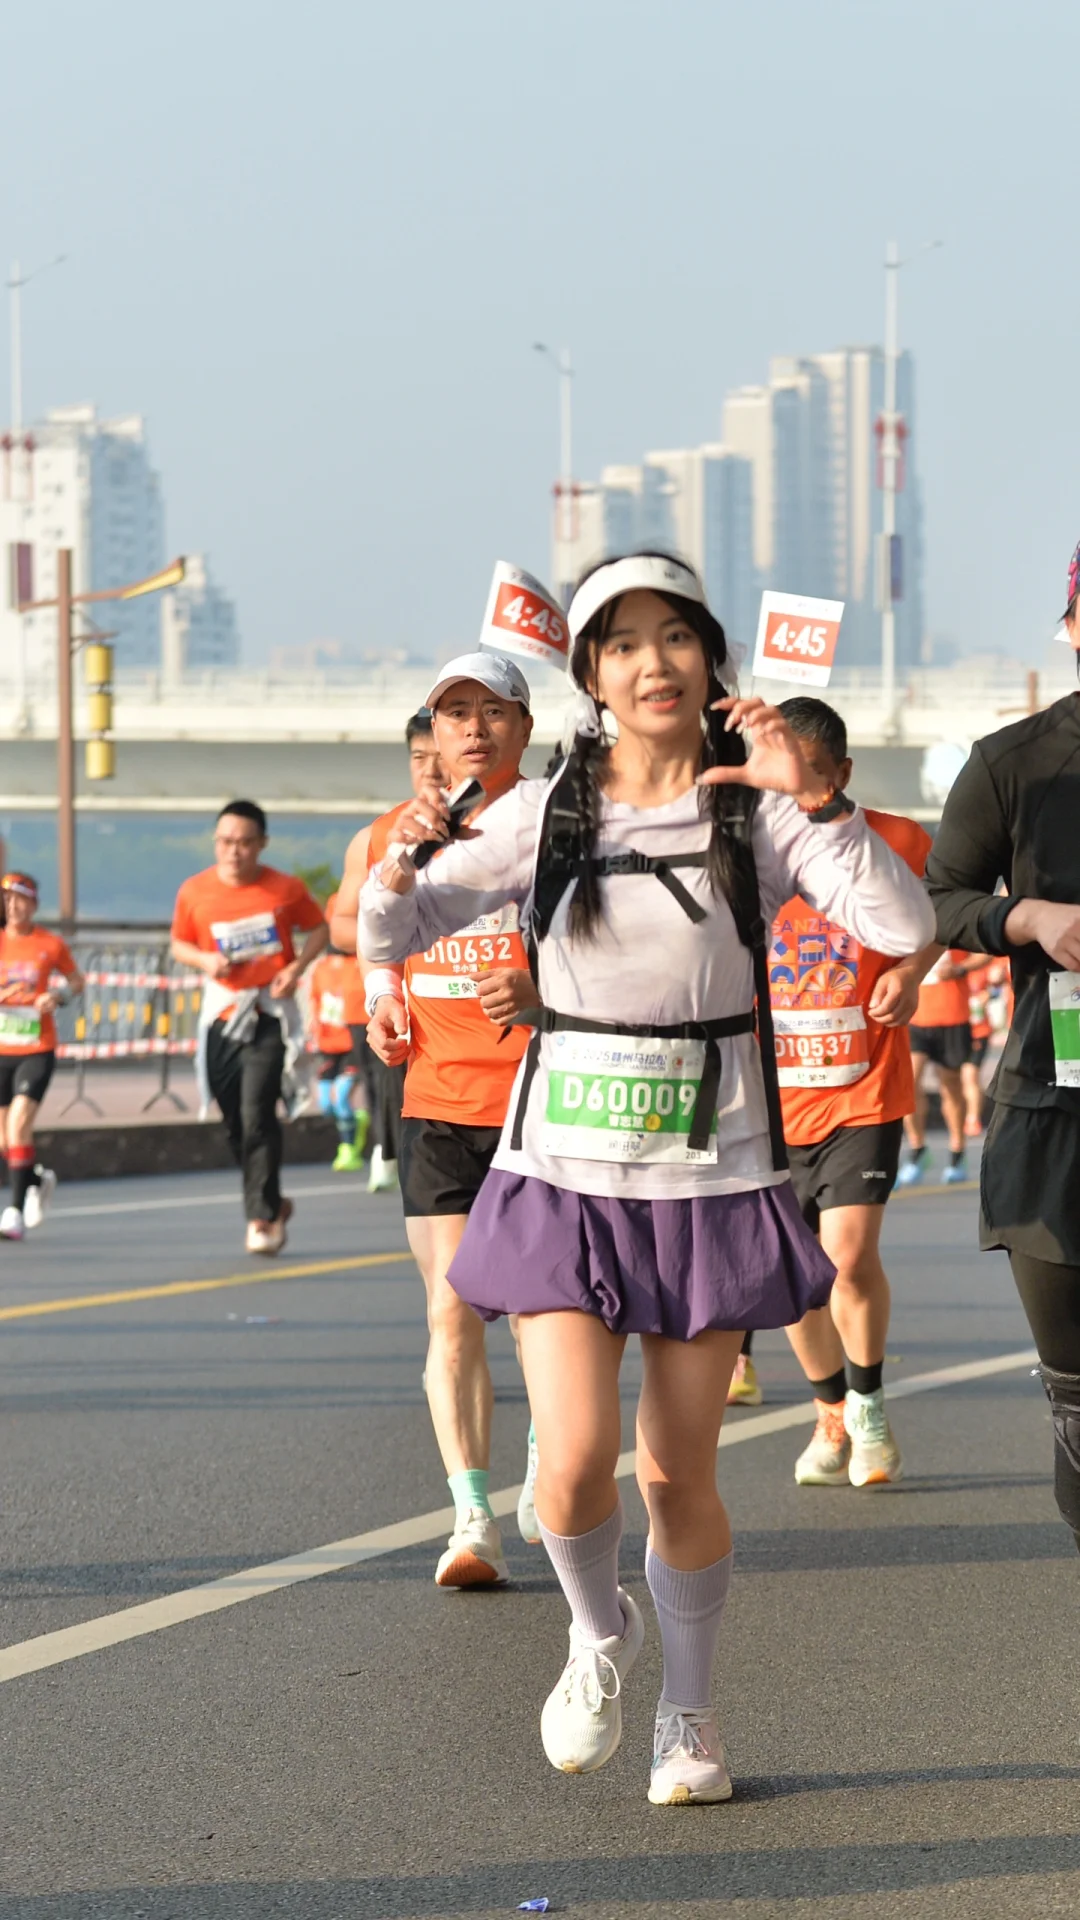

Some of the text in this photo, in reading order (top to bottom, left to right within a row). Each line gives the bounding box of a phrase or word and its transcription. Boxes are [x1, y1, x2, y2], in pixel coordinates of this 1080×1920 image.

[503, 596, 563, 641] 4:45
[771, 622, 827, 658] 4:45
[562, 1076, 697, 1116] D60009
